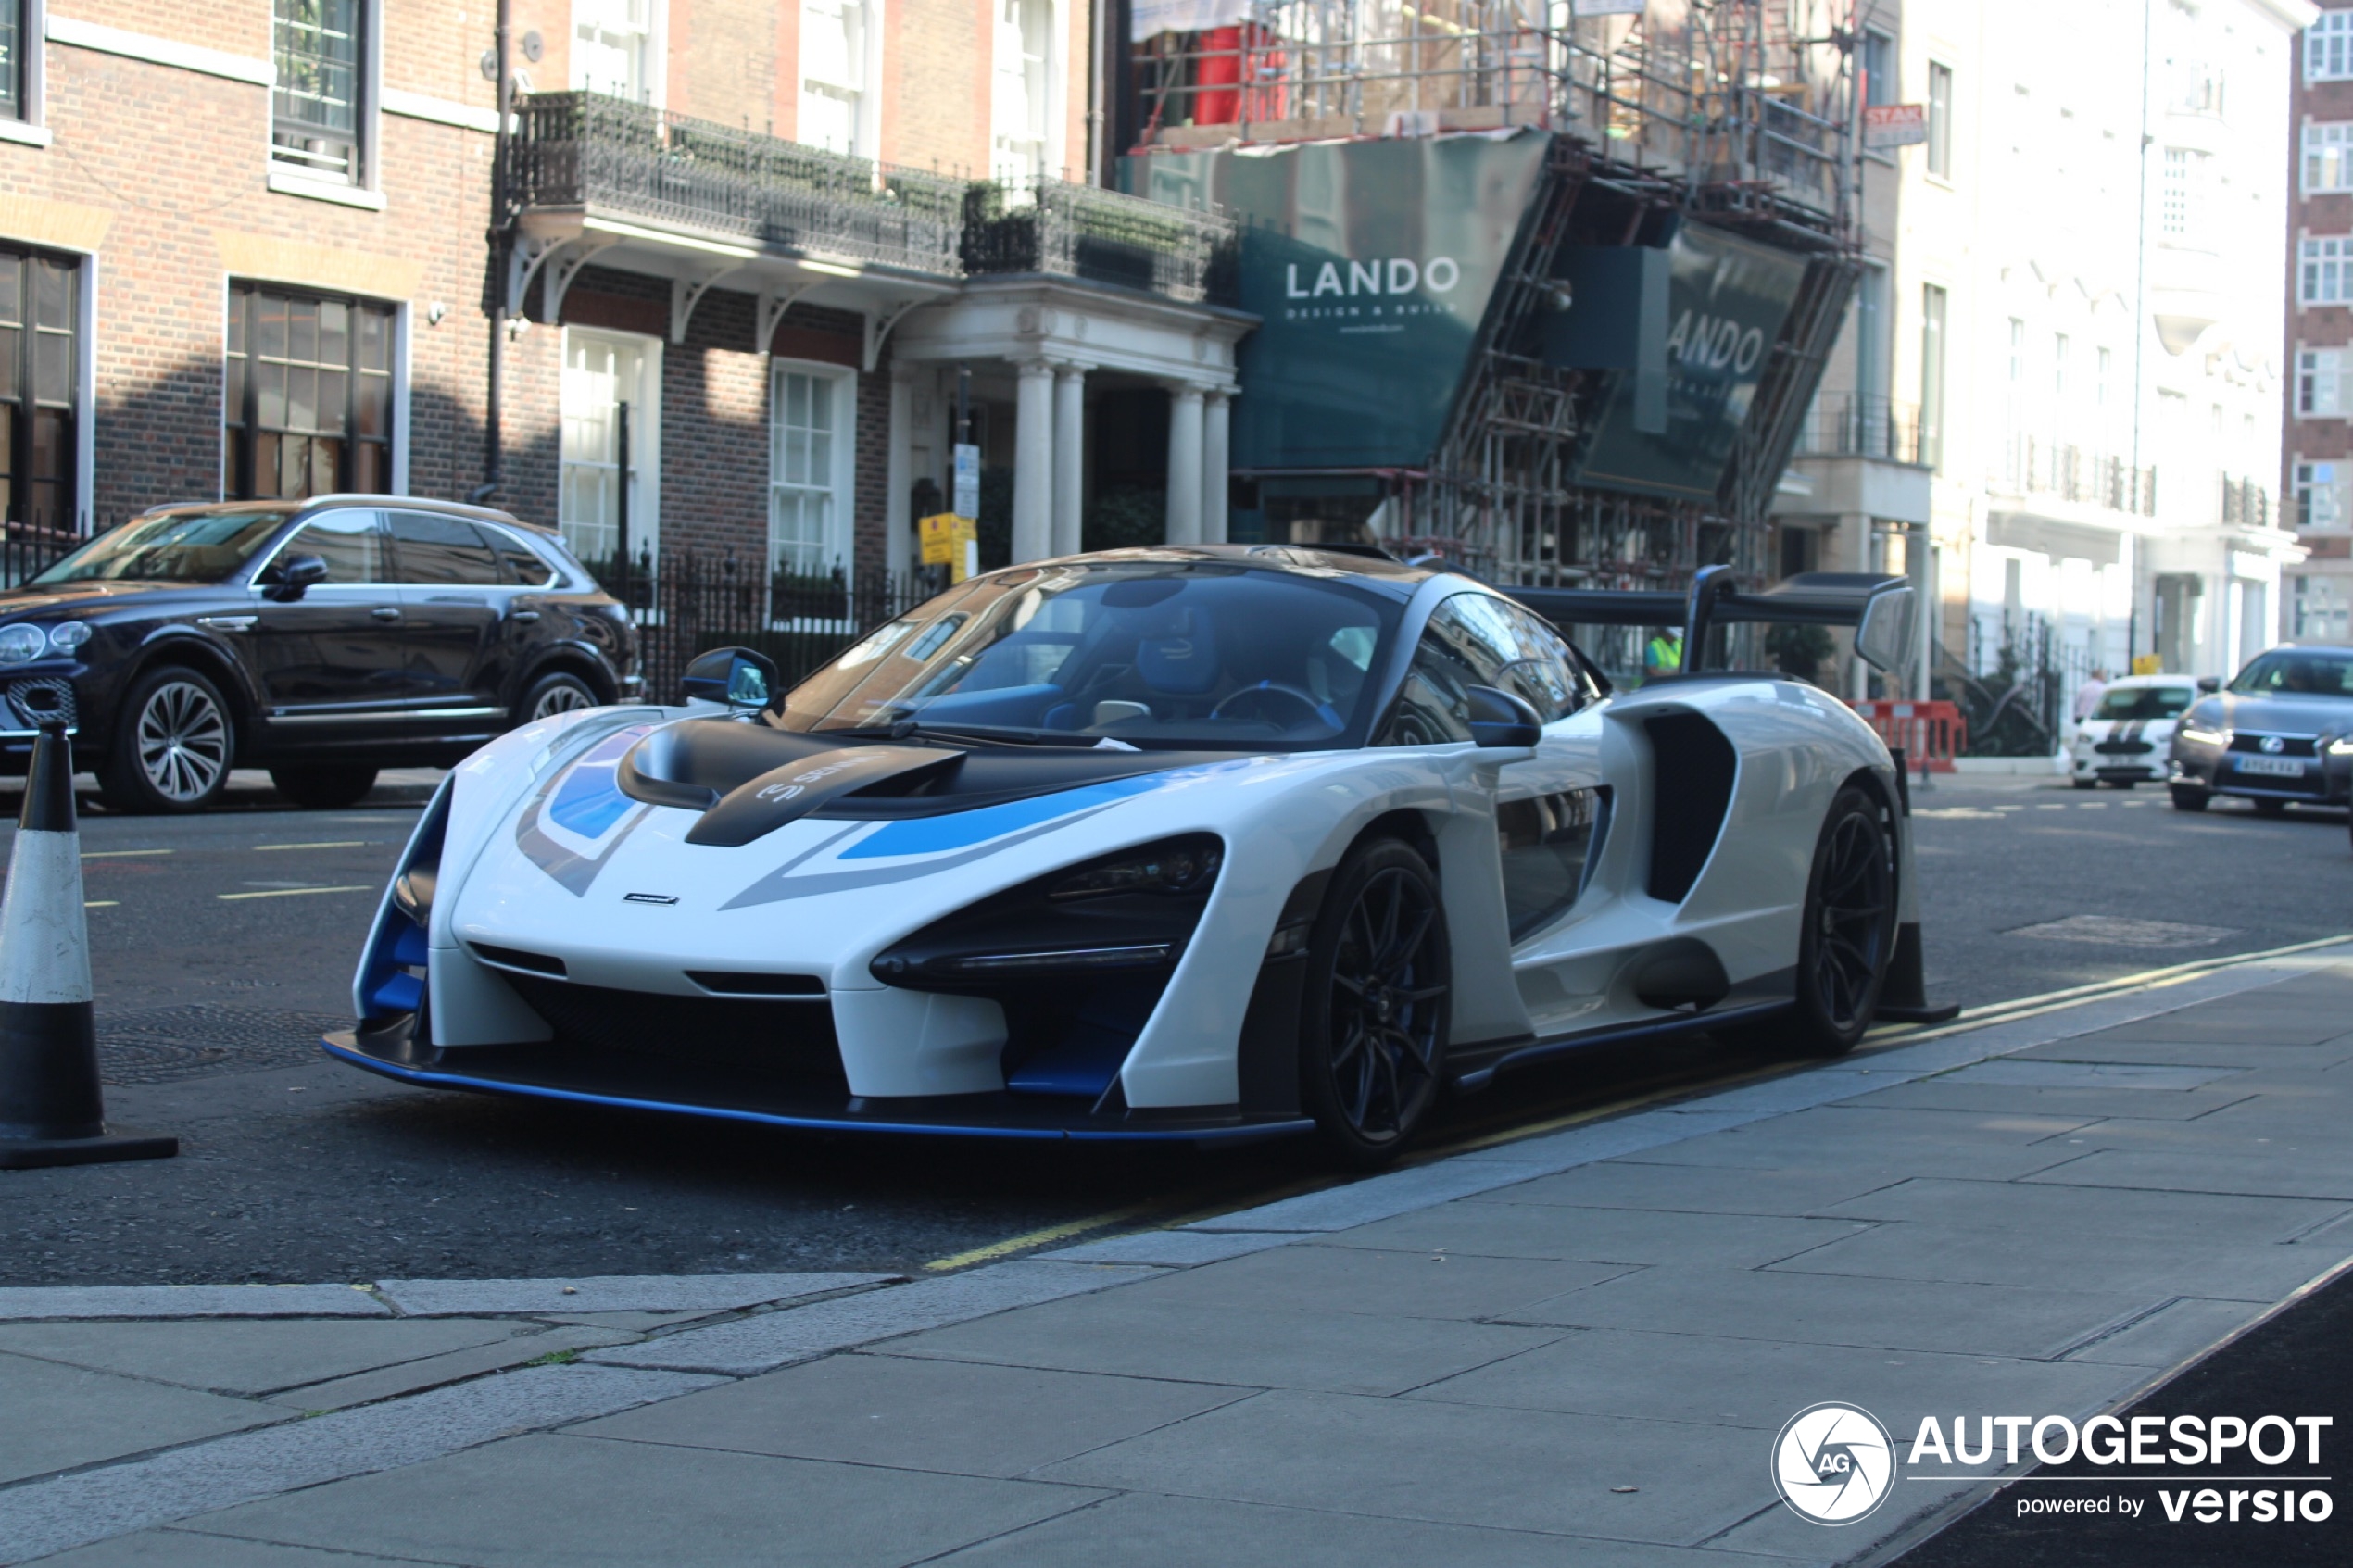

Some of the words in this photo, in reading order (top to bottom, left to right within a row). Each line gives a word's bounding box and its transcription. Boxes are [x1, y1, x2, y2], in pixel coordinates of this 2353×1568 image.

[1287, 257, 1460, 298] LANDO
[1286, 306, 1360, 320] DESIGN
[1372, 306, 1382, 316] &
[1396, 303, 1458, 315] BUILD
